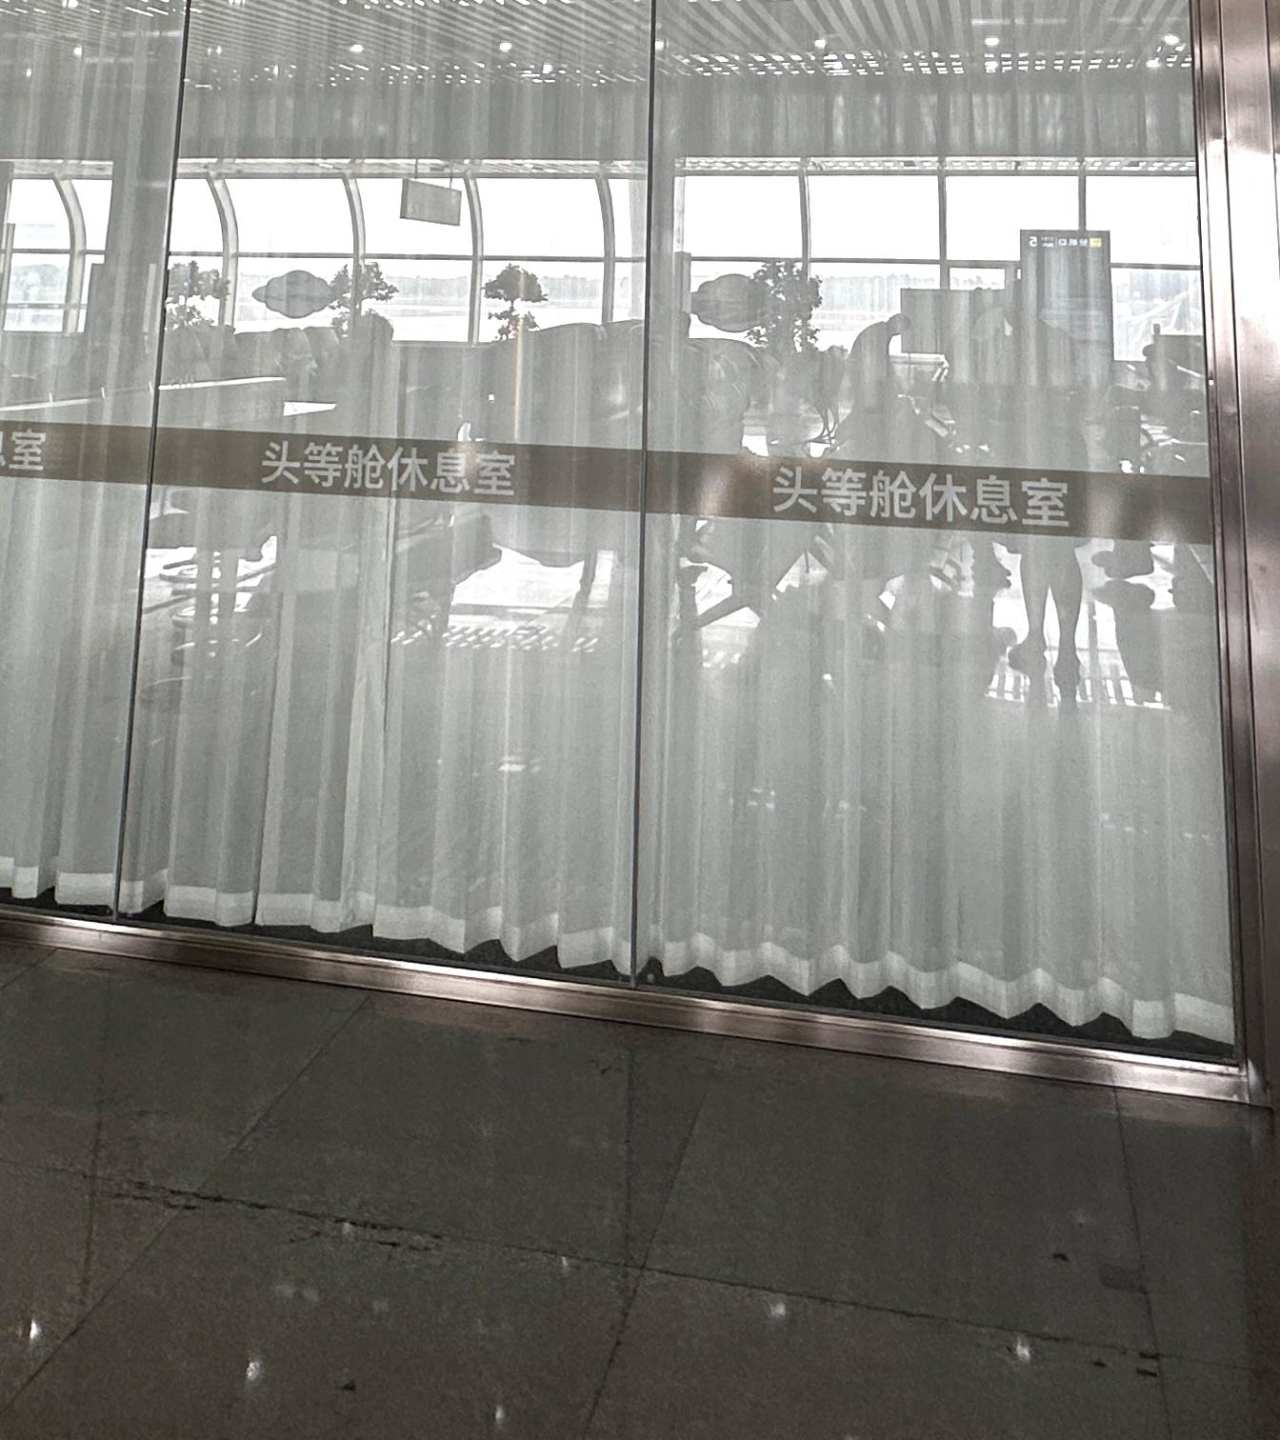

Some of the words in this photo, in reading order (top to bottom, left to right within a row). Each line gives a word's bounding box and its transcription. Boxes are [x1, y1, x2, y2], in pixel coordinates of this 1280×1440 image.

[260, 439, 517, 498] 头等舱休息室
[770, 464, 1071, 529] 头等舱休息室
